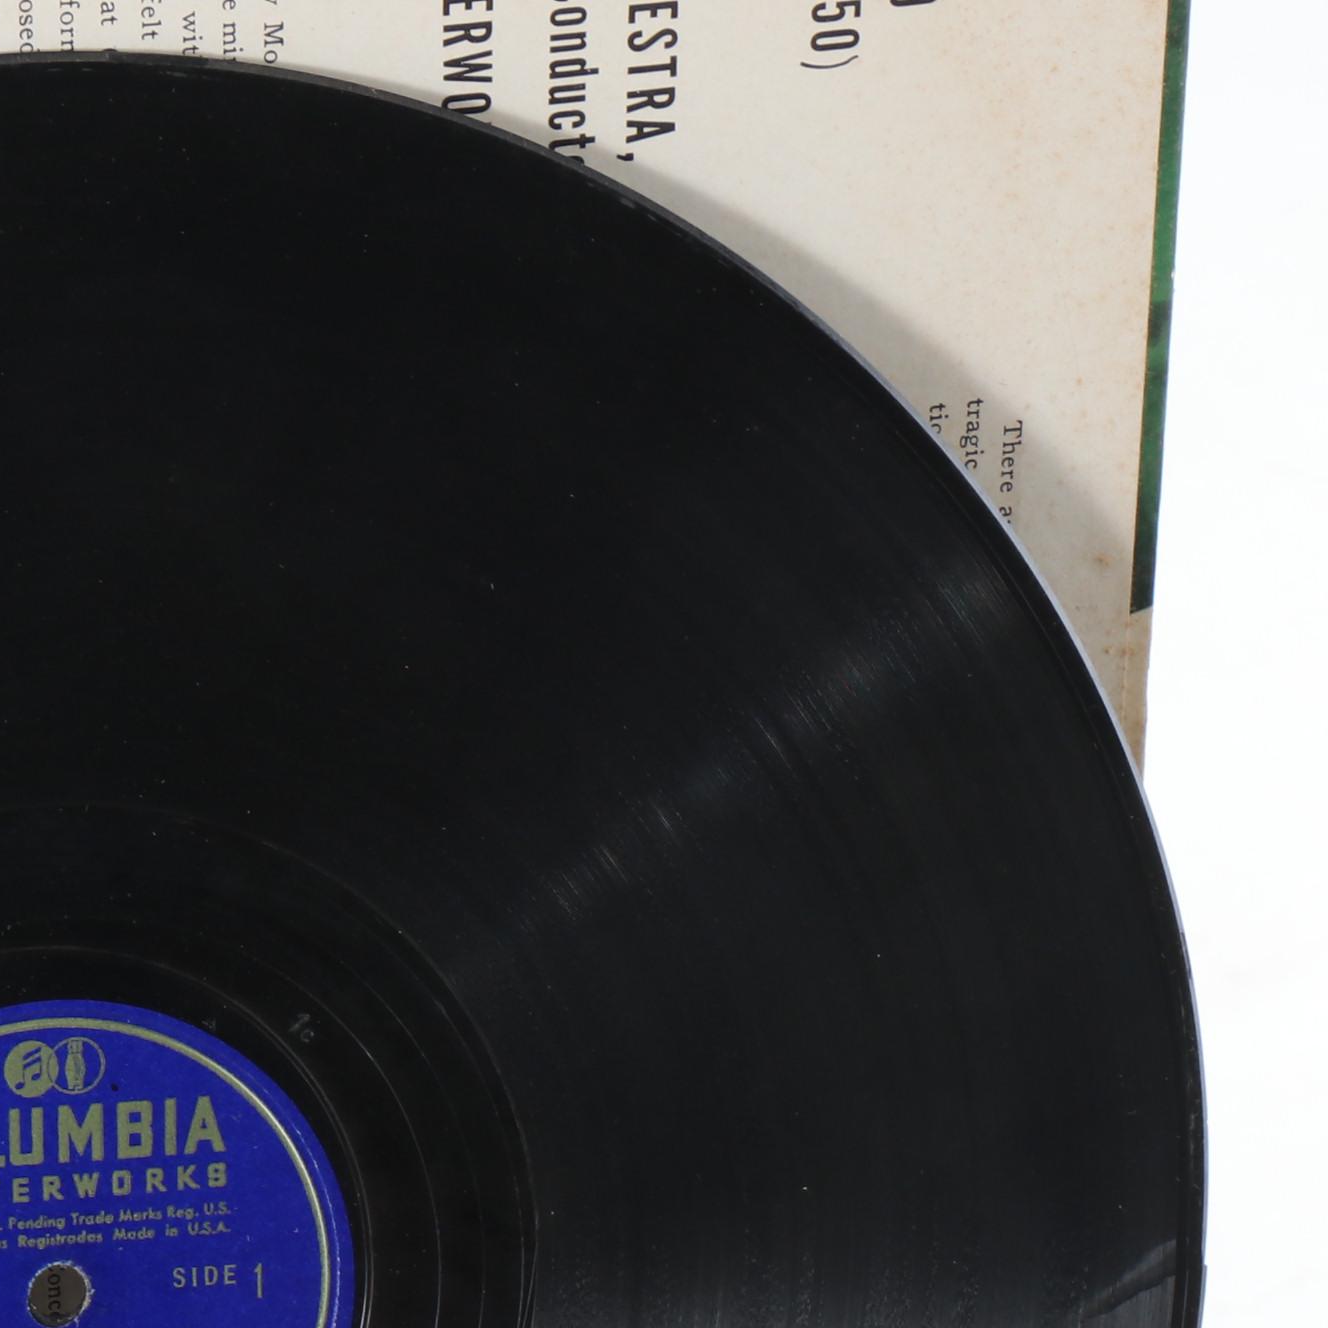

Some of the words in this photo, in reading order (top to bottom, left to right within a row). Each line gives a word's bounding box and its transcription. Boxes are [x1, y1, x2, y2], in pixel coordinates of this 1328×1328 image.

[182, 11, 205, 58] wit
[441, 0, 494, 126] ERWO
[548, 0, 599, 167] onduct
[617, 0, 679, 162] ESTRA,
[959, 398, 984, 470] tragic
[999, 420, 1023, 493] There
[8, 1213, 67, 1232] Pending
[71, 1210, 114, 1226] Trade
[119, 1207, 163, 1222] Marks
[166, 1205, 199, 1223] Reg.
[112, 1226, 156, 1240] Made
[164, 1223, 179, 1238] in
[173, 1264, 238, 1288] SIDE
[254, 1262, 264, 1299] 1
